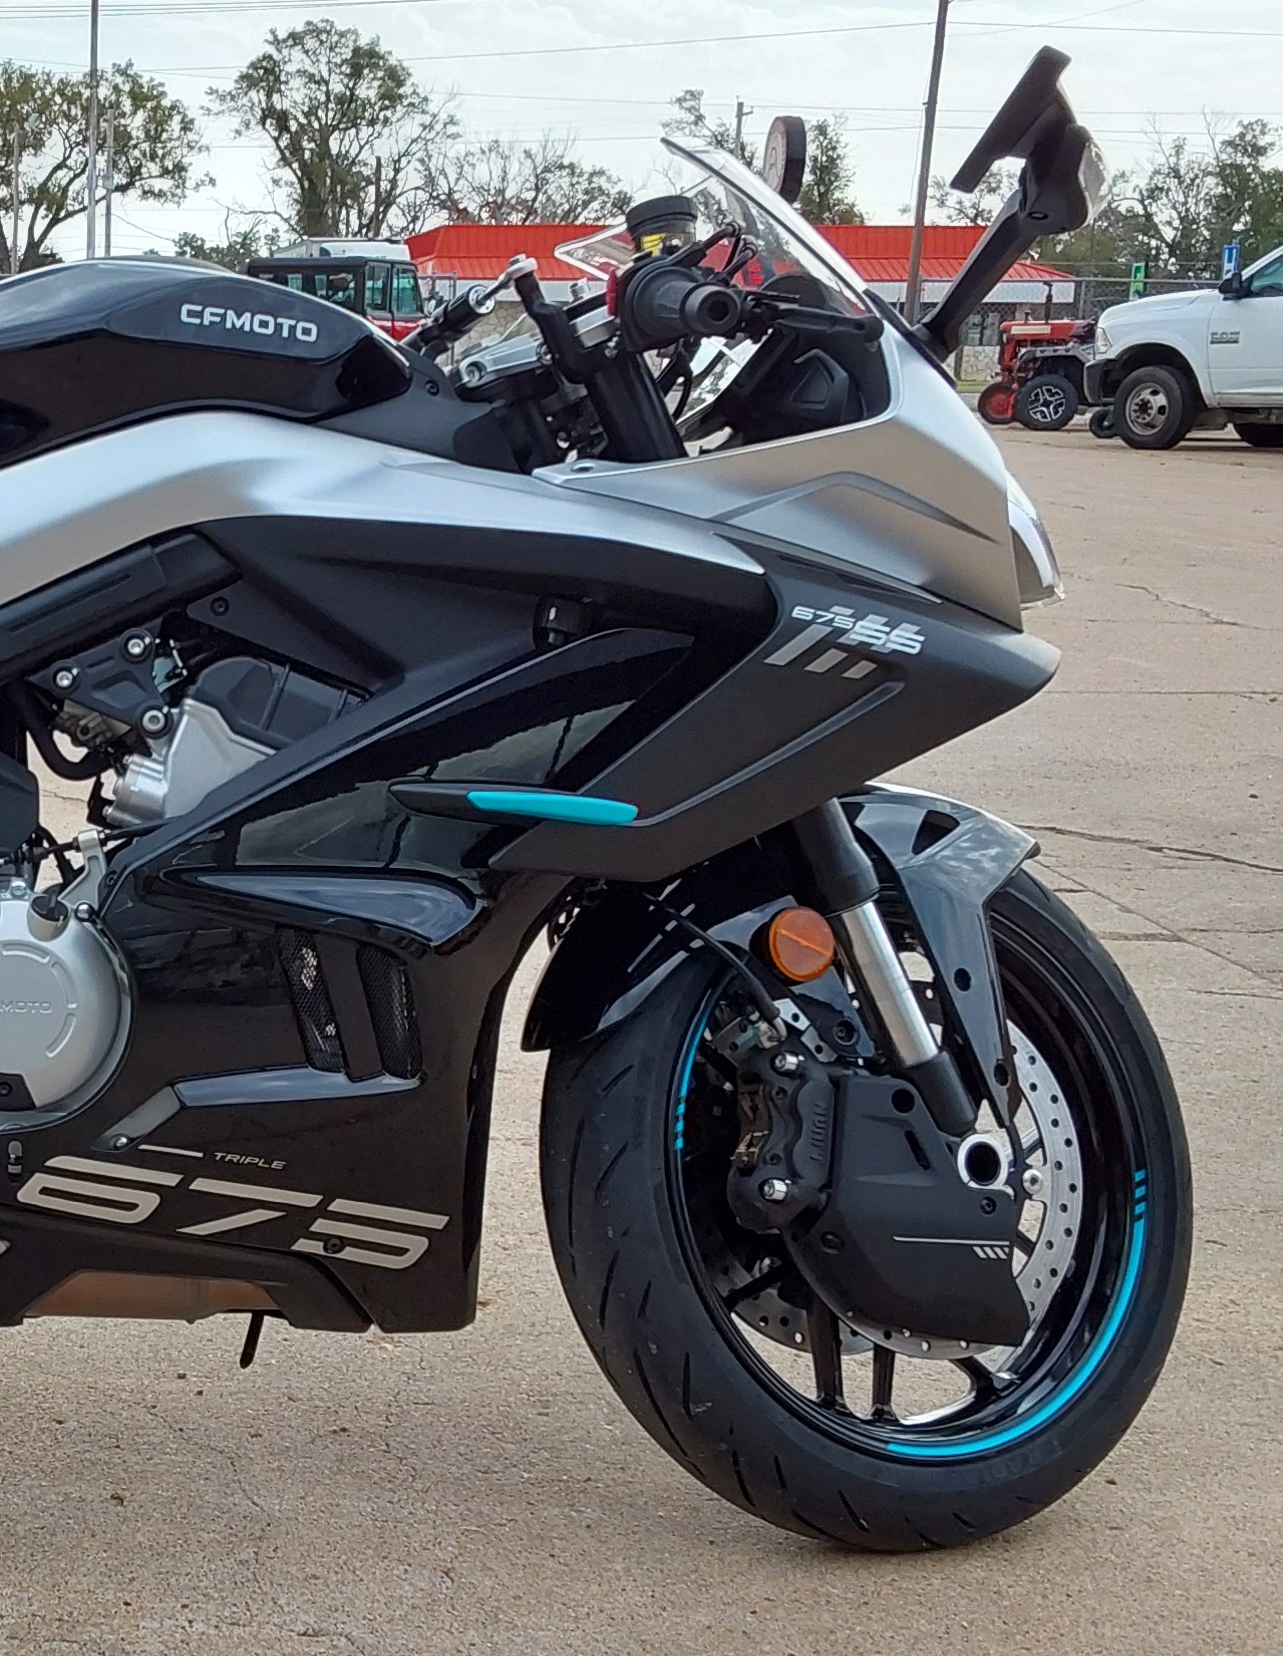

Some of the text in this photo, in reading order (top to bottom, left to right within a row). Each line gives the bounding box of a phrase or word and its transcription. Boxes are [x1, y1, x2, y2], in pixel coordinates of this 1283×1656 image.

[180, 303, 318, 342] CFMOTO
[791, 605, 925, 655] 675 SS
[213, 1152, 286, 1170] TRIPLE
[17, 1155, 450, 1270] 675
